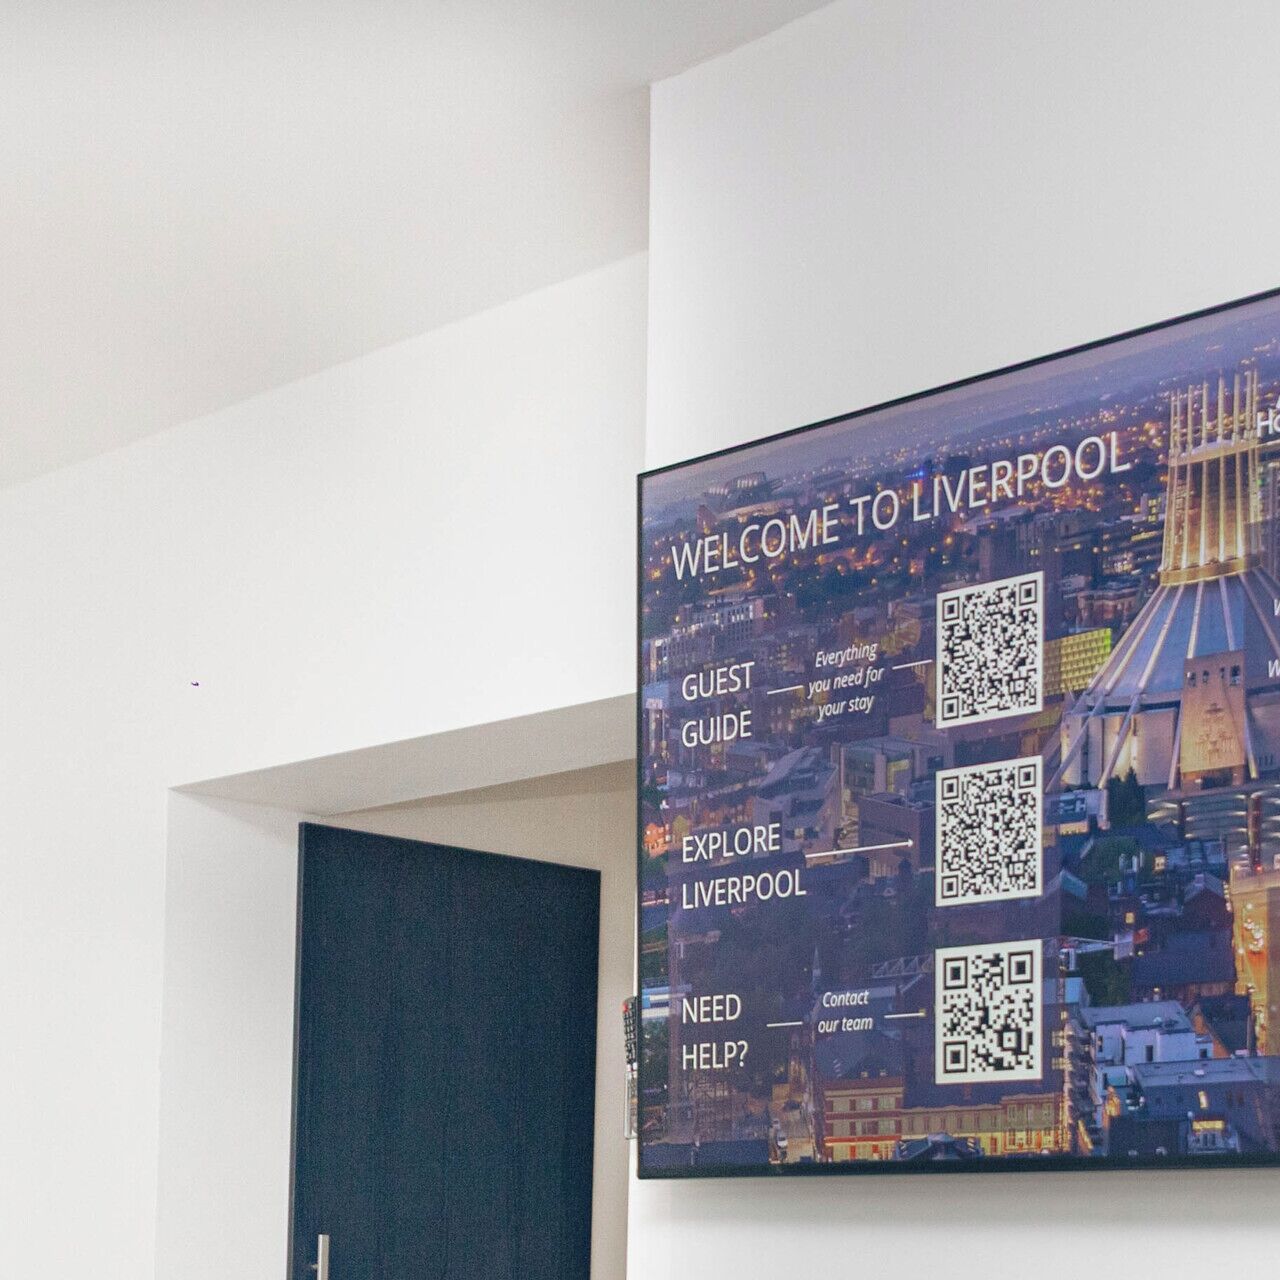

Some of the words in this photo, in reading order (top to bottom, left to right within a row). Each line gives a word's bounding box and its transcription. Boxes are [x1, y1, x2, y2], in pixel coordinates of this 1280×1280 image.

[671, 503, 840, 581] WELCOME
[849, 489, 901, 534] TO
[912, 431, 1131, 522] LIVERPOOL
[815, 643, 878, 668] Everything
[682, 661, 755, 702] GUEST
[807, 678, 831, 700] you
[833, 667, 864, 690] need
[864, 666, 885, 689] for
[817, 701, 847, 723] your
[848, 695, 875, 714] stay
[682, 709, 753, 748] GUIDE
[682, 823, 782, 864] EXPLORE
[682, 870, 807, 910] LIVERPOOL
[682, 993, 742, 1025] NEED
[822, 989, 870, 1008] Contact
[818, 1019, 840, 1033] our
[841, 1016, 873, 1032] team
[682, 1040, 749, 1071] HELP?
